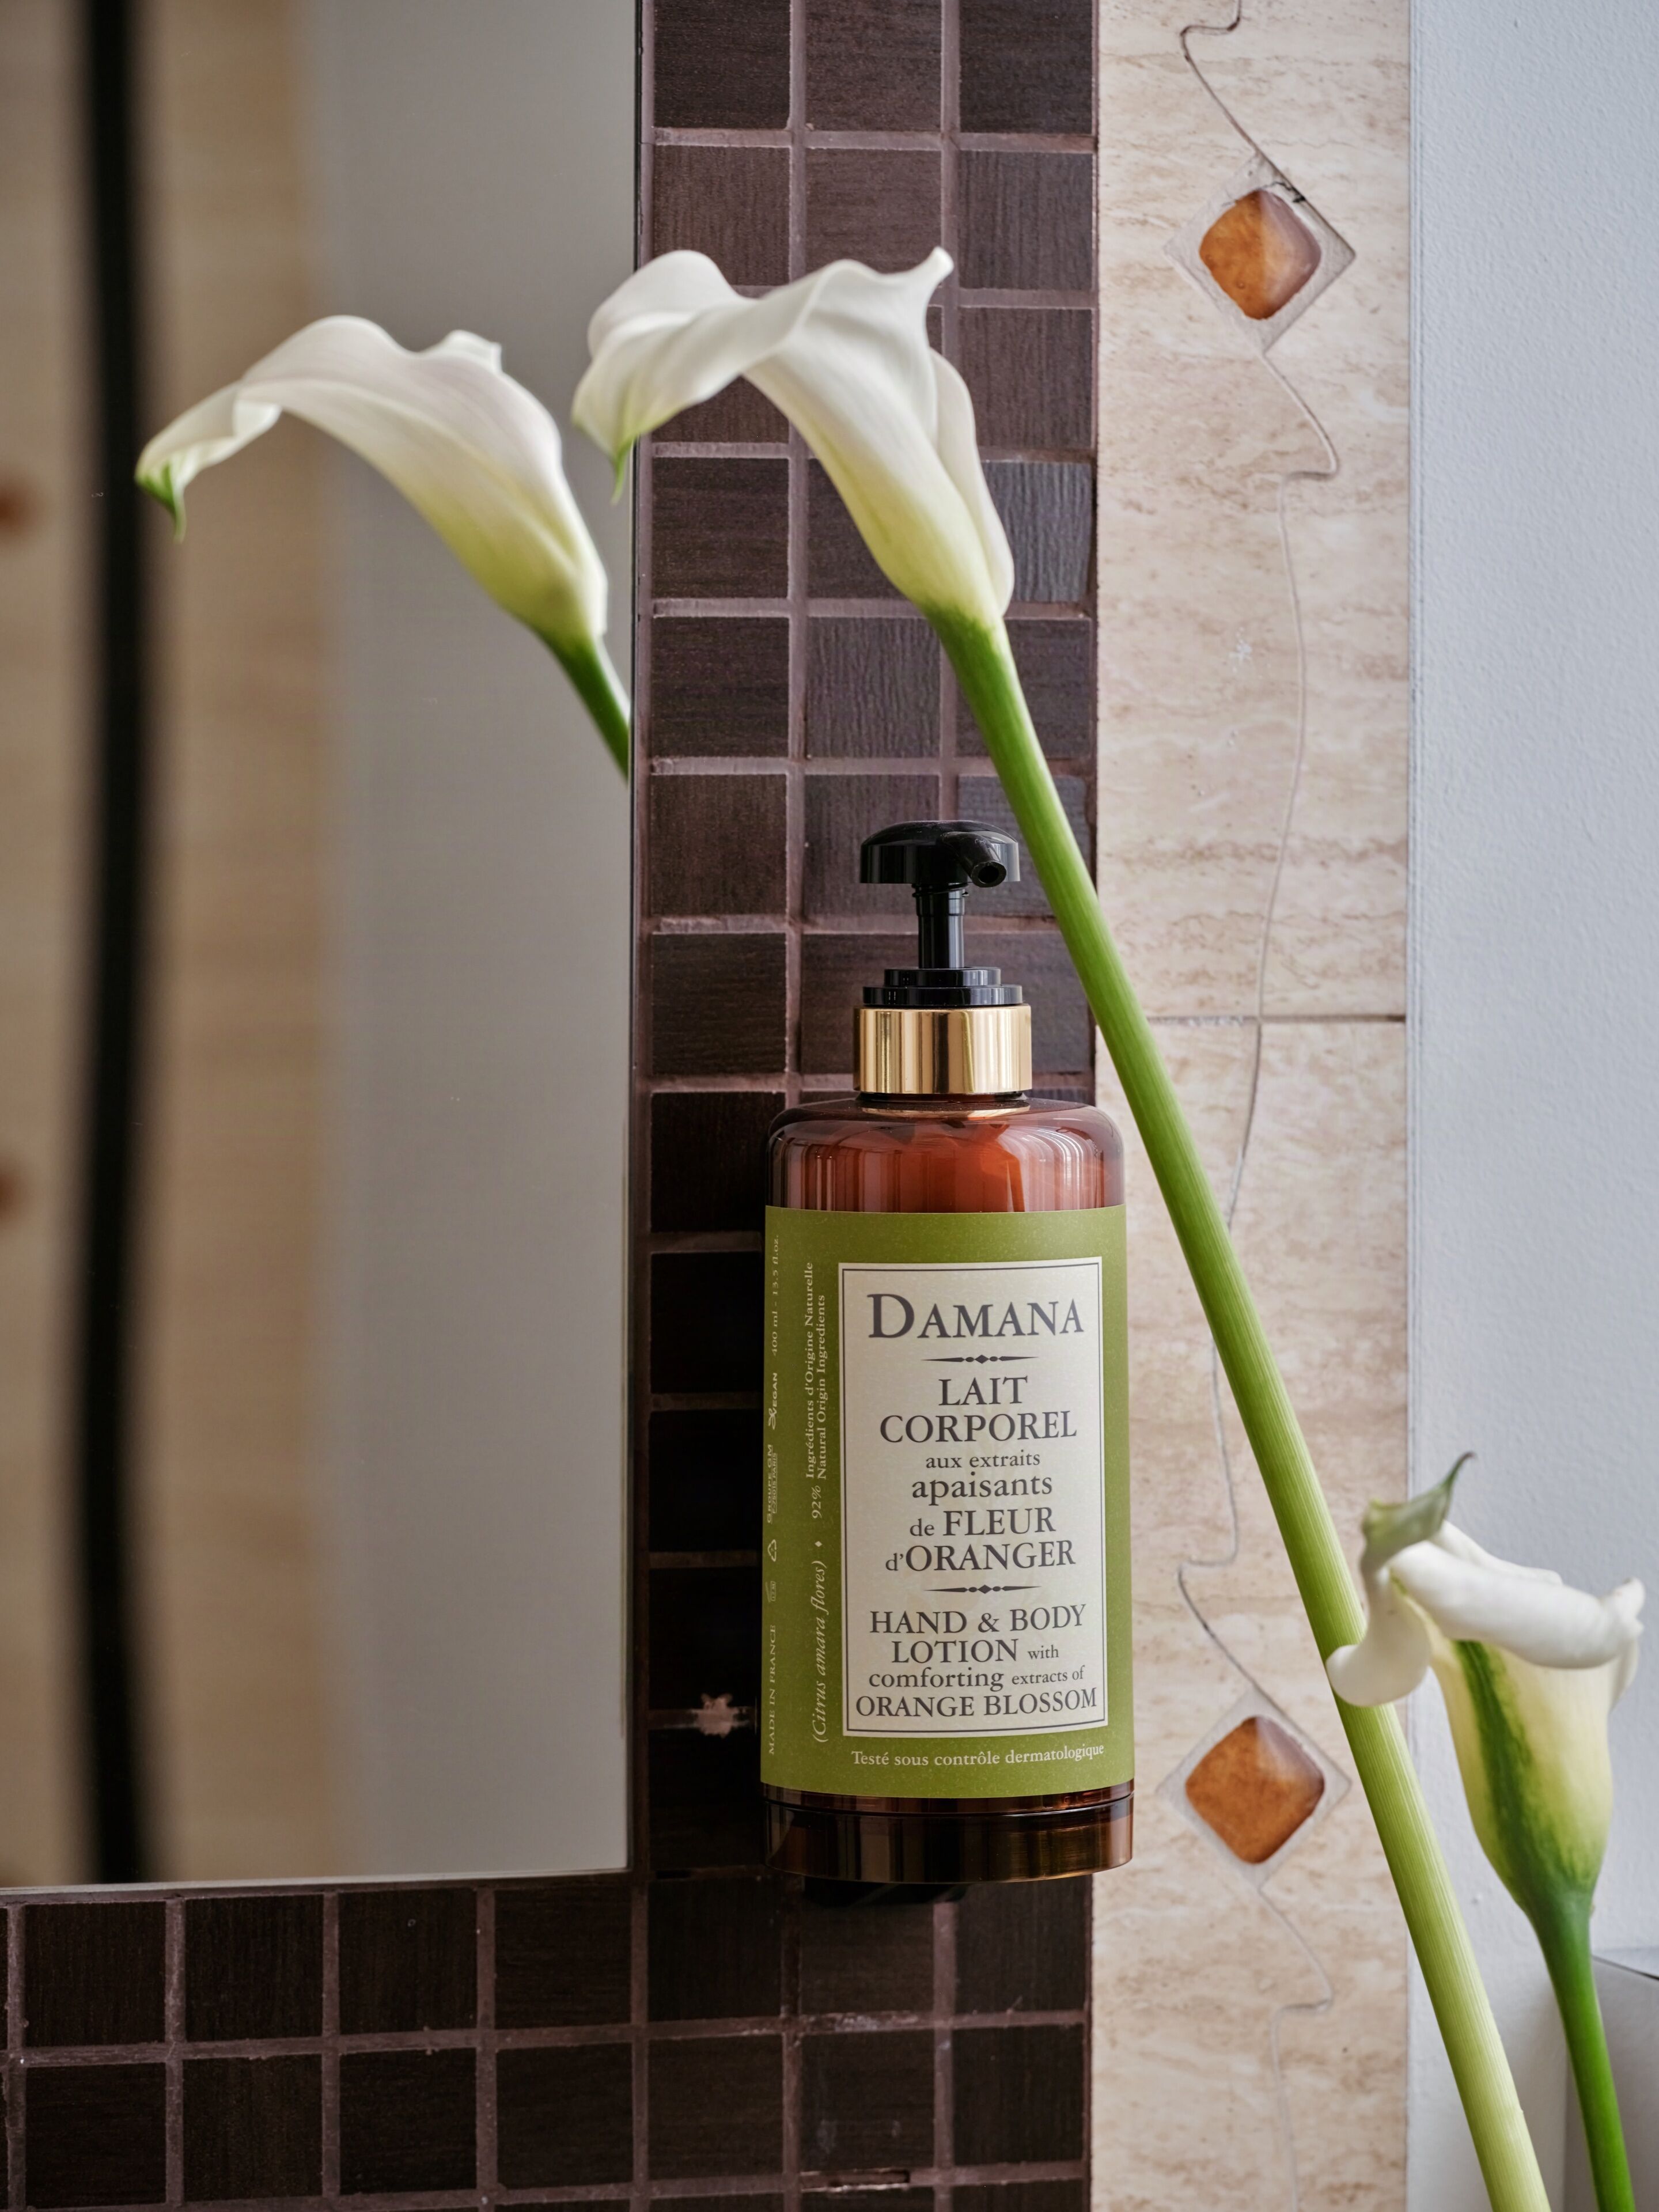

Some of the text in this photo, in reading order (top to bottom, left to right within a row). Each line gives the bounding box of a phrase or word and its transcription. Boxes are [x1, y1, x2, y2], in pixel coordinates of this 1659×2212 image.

[805, 1263, 813, 1327] Naturelle
[772, 1311, 778, 1327] ml
[867, 1293, 1084, 1339] DAMANA
[816, 1296, 828, 1480] Natural Origin Ingredients
[938, 1376, 1028, 1406] LAIT
[805, 1400, 816, 1479] Ingrédients
[880, 1411, 1076, 1443] CORPOREL
[926, 1449, 1040, 1468] aux extraits
[812, 1485, 822, 1519] 92%
[911, 1471, 1052, 1506] apaisants
[910, 1508, 1056, 1536] de FLEUR
[870, 1604, 1085, 1634] HAND & BODY
[810, 1560, 829, 1743] (Citrus amara flores)
[892, 1639, 1058, 1664] LOTION with
[869, 1665, 1085, 1692] comforting extracts of
[770, 1689, 775, 1705] IN
[856, 1688, 1096, 1717] ORANGE BLOSSOM
[851, 1744, 1104, 1765] Testé sous contrôle dermatologique
